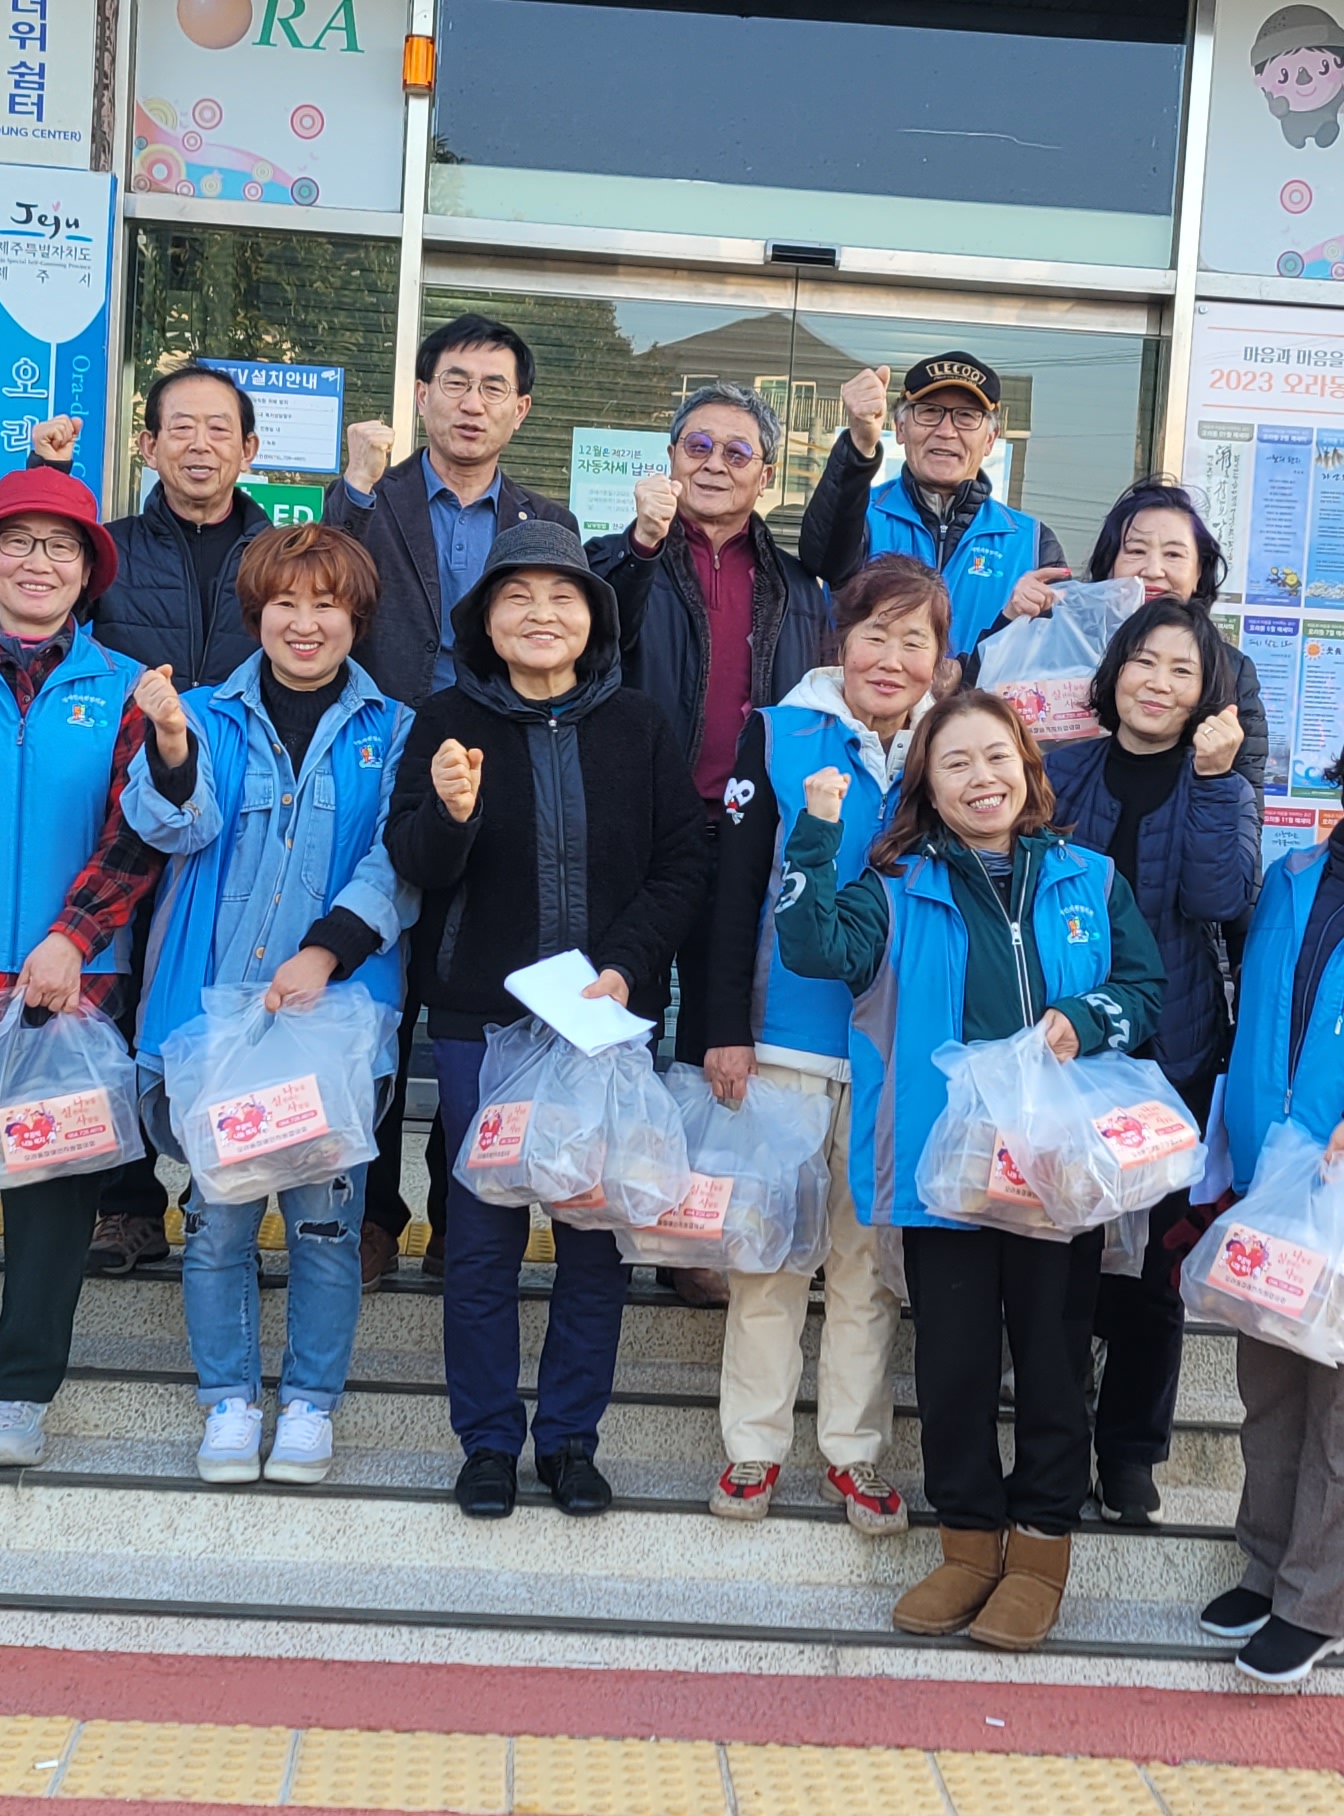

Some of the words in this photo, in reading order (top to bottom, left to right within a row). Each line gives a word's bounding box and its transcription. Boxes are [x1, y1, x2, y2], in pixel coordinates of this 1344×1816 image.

[7, 61, 46, 122] 쉼터
[31, 128, 82, 142] CENTER)
[10, 201, 80, 240] Jeju
[1243, 346, 1292, 365] 마음과
[1296, 351, 1344, 369] 마음을
[251, 369, 318, 390] 설치안내
[1209, 369, 1274, 393] 2023
[577, 459, 628, 475] 자동차세
